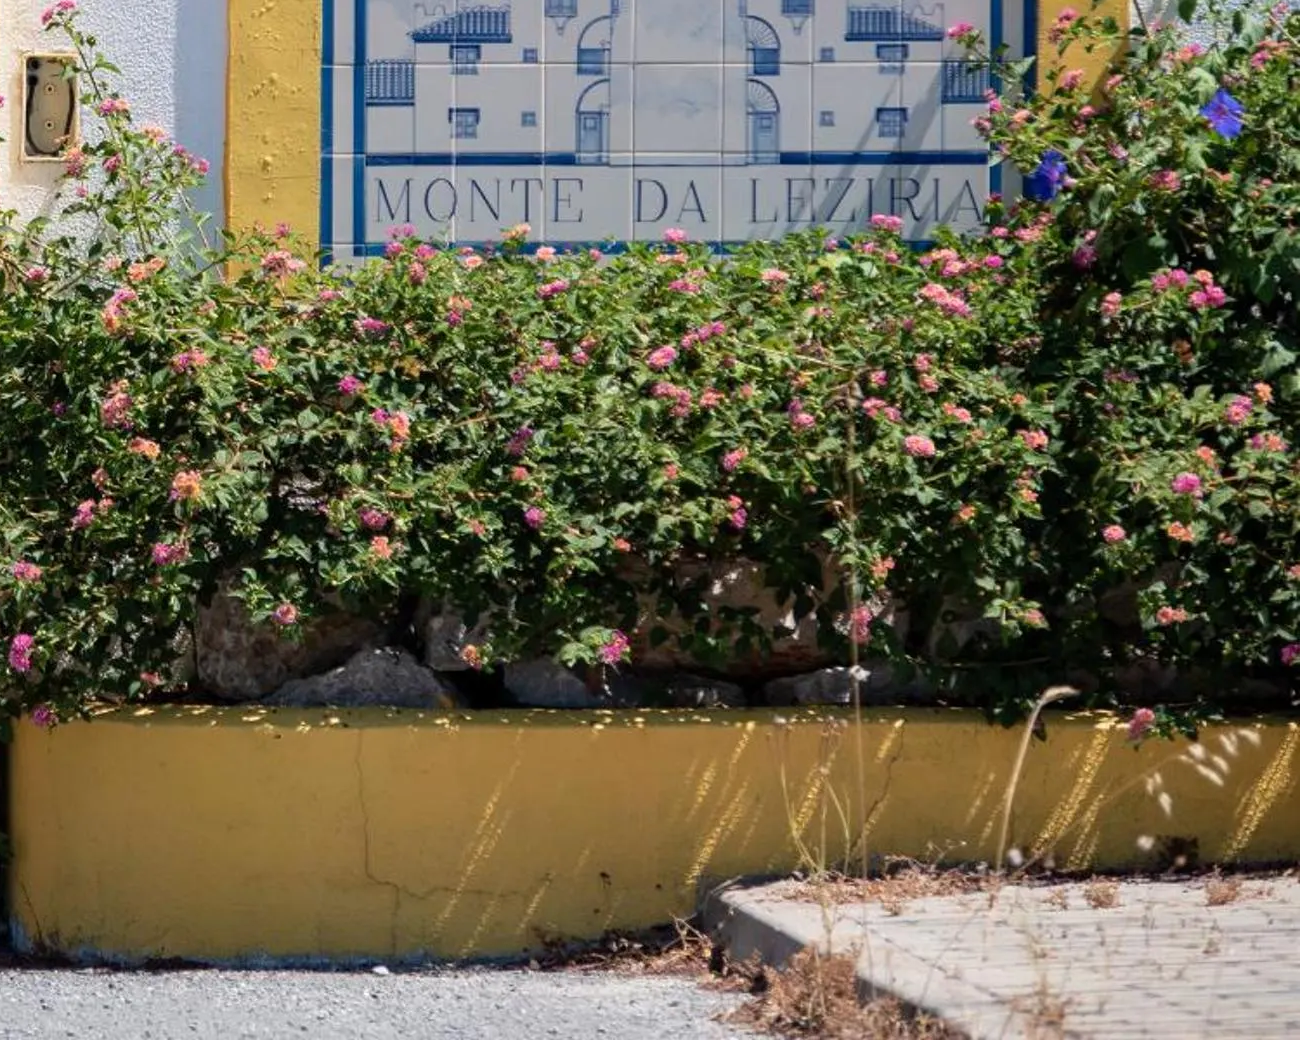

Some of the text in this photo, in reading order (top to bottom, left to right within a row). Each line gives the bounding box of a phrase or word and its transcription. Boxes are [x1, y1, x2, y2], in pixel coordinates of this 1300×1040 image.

[375, 177, 984, 224] MONTE DA LEZIRIA
